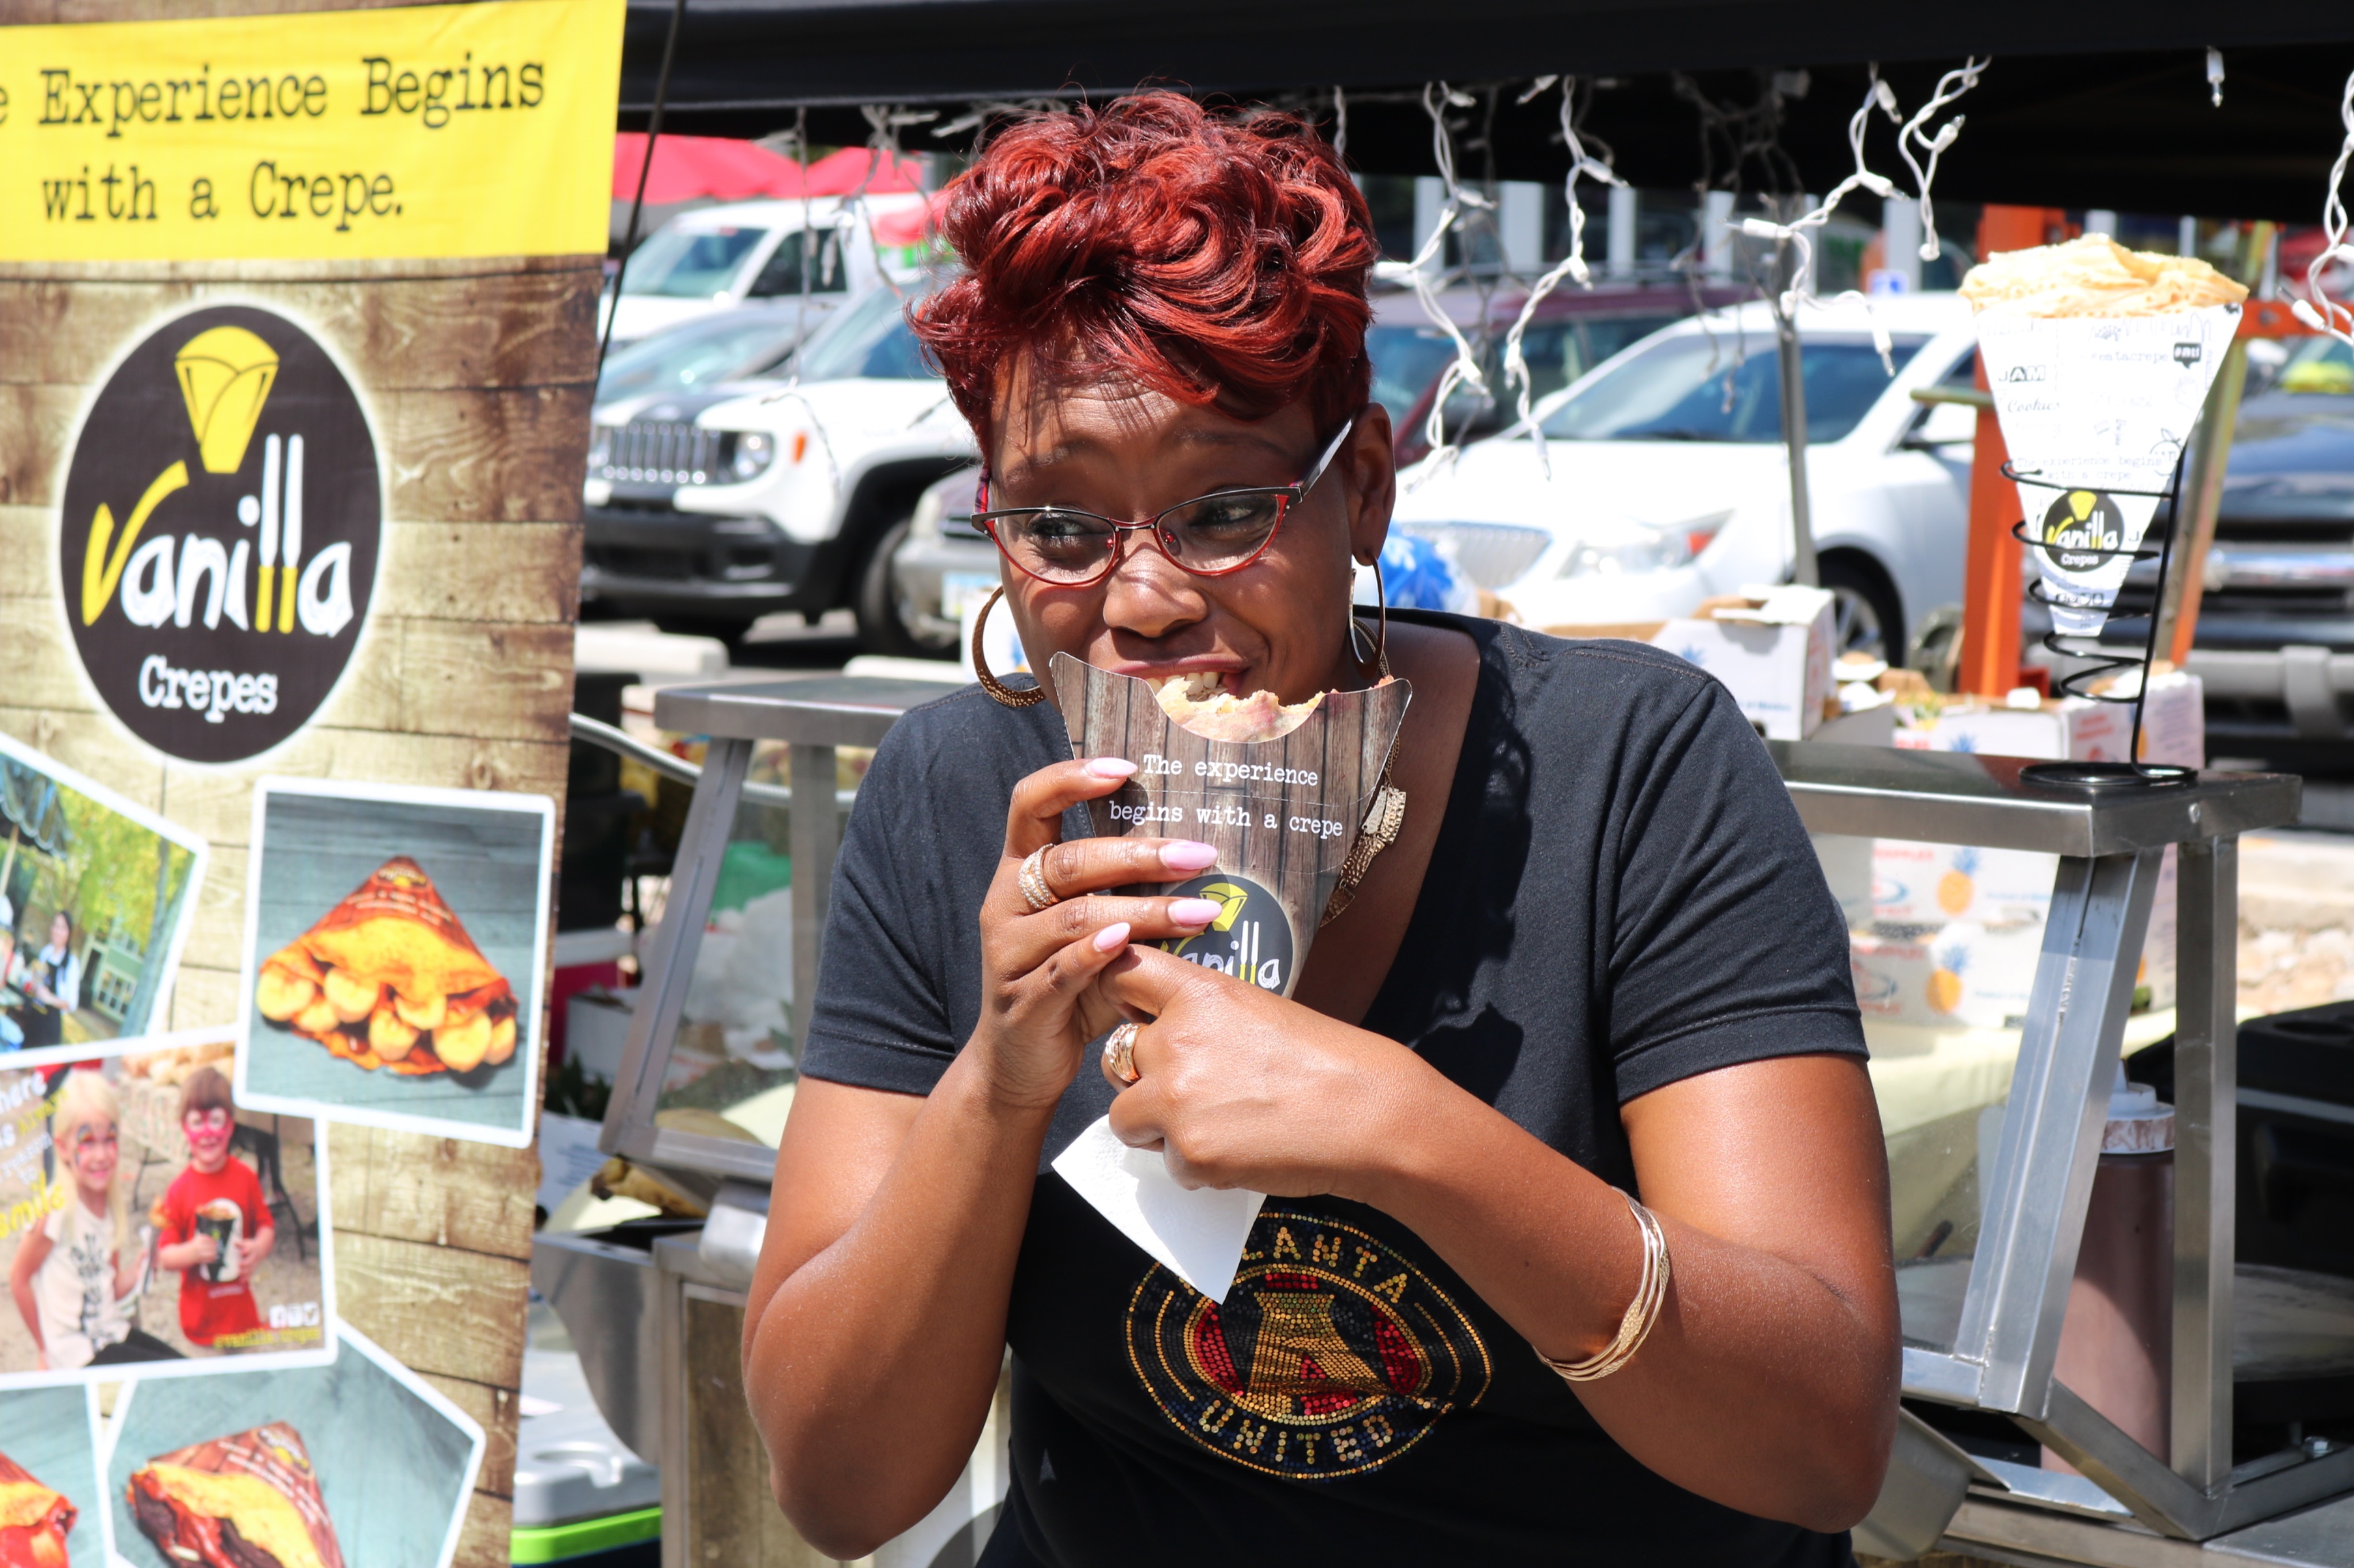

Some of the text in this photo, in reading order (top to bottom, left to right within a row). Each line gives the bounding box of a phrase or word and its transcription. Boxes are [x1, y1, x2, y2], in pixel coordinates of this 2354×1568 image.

[39, 63, 327, 137] Experience
[359, 52, 545, 129] Begins
[43, 160, 403, 231] with a Crepe.
[1998, 365, 2046, 382] JAM
[2043, 455, 2110, 467] experience
[2119, 456, 2162, 468] begins
[2048, 470, 2074, 480] with
[2097, 472, 2132, 481] crepe
[82, 434, 353, 638] Vanilla
[2061, 554, 2099, 567] Crepes
[139, 655, 278, 723] Crepes
[1143, 754, 1318, 787] The experience
[1109, 801, 1343, 839] begins with a crepe
[1199, 1400, 1393, 1465] UNITED
